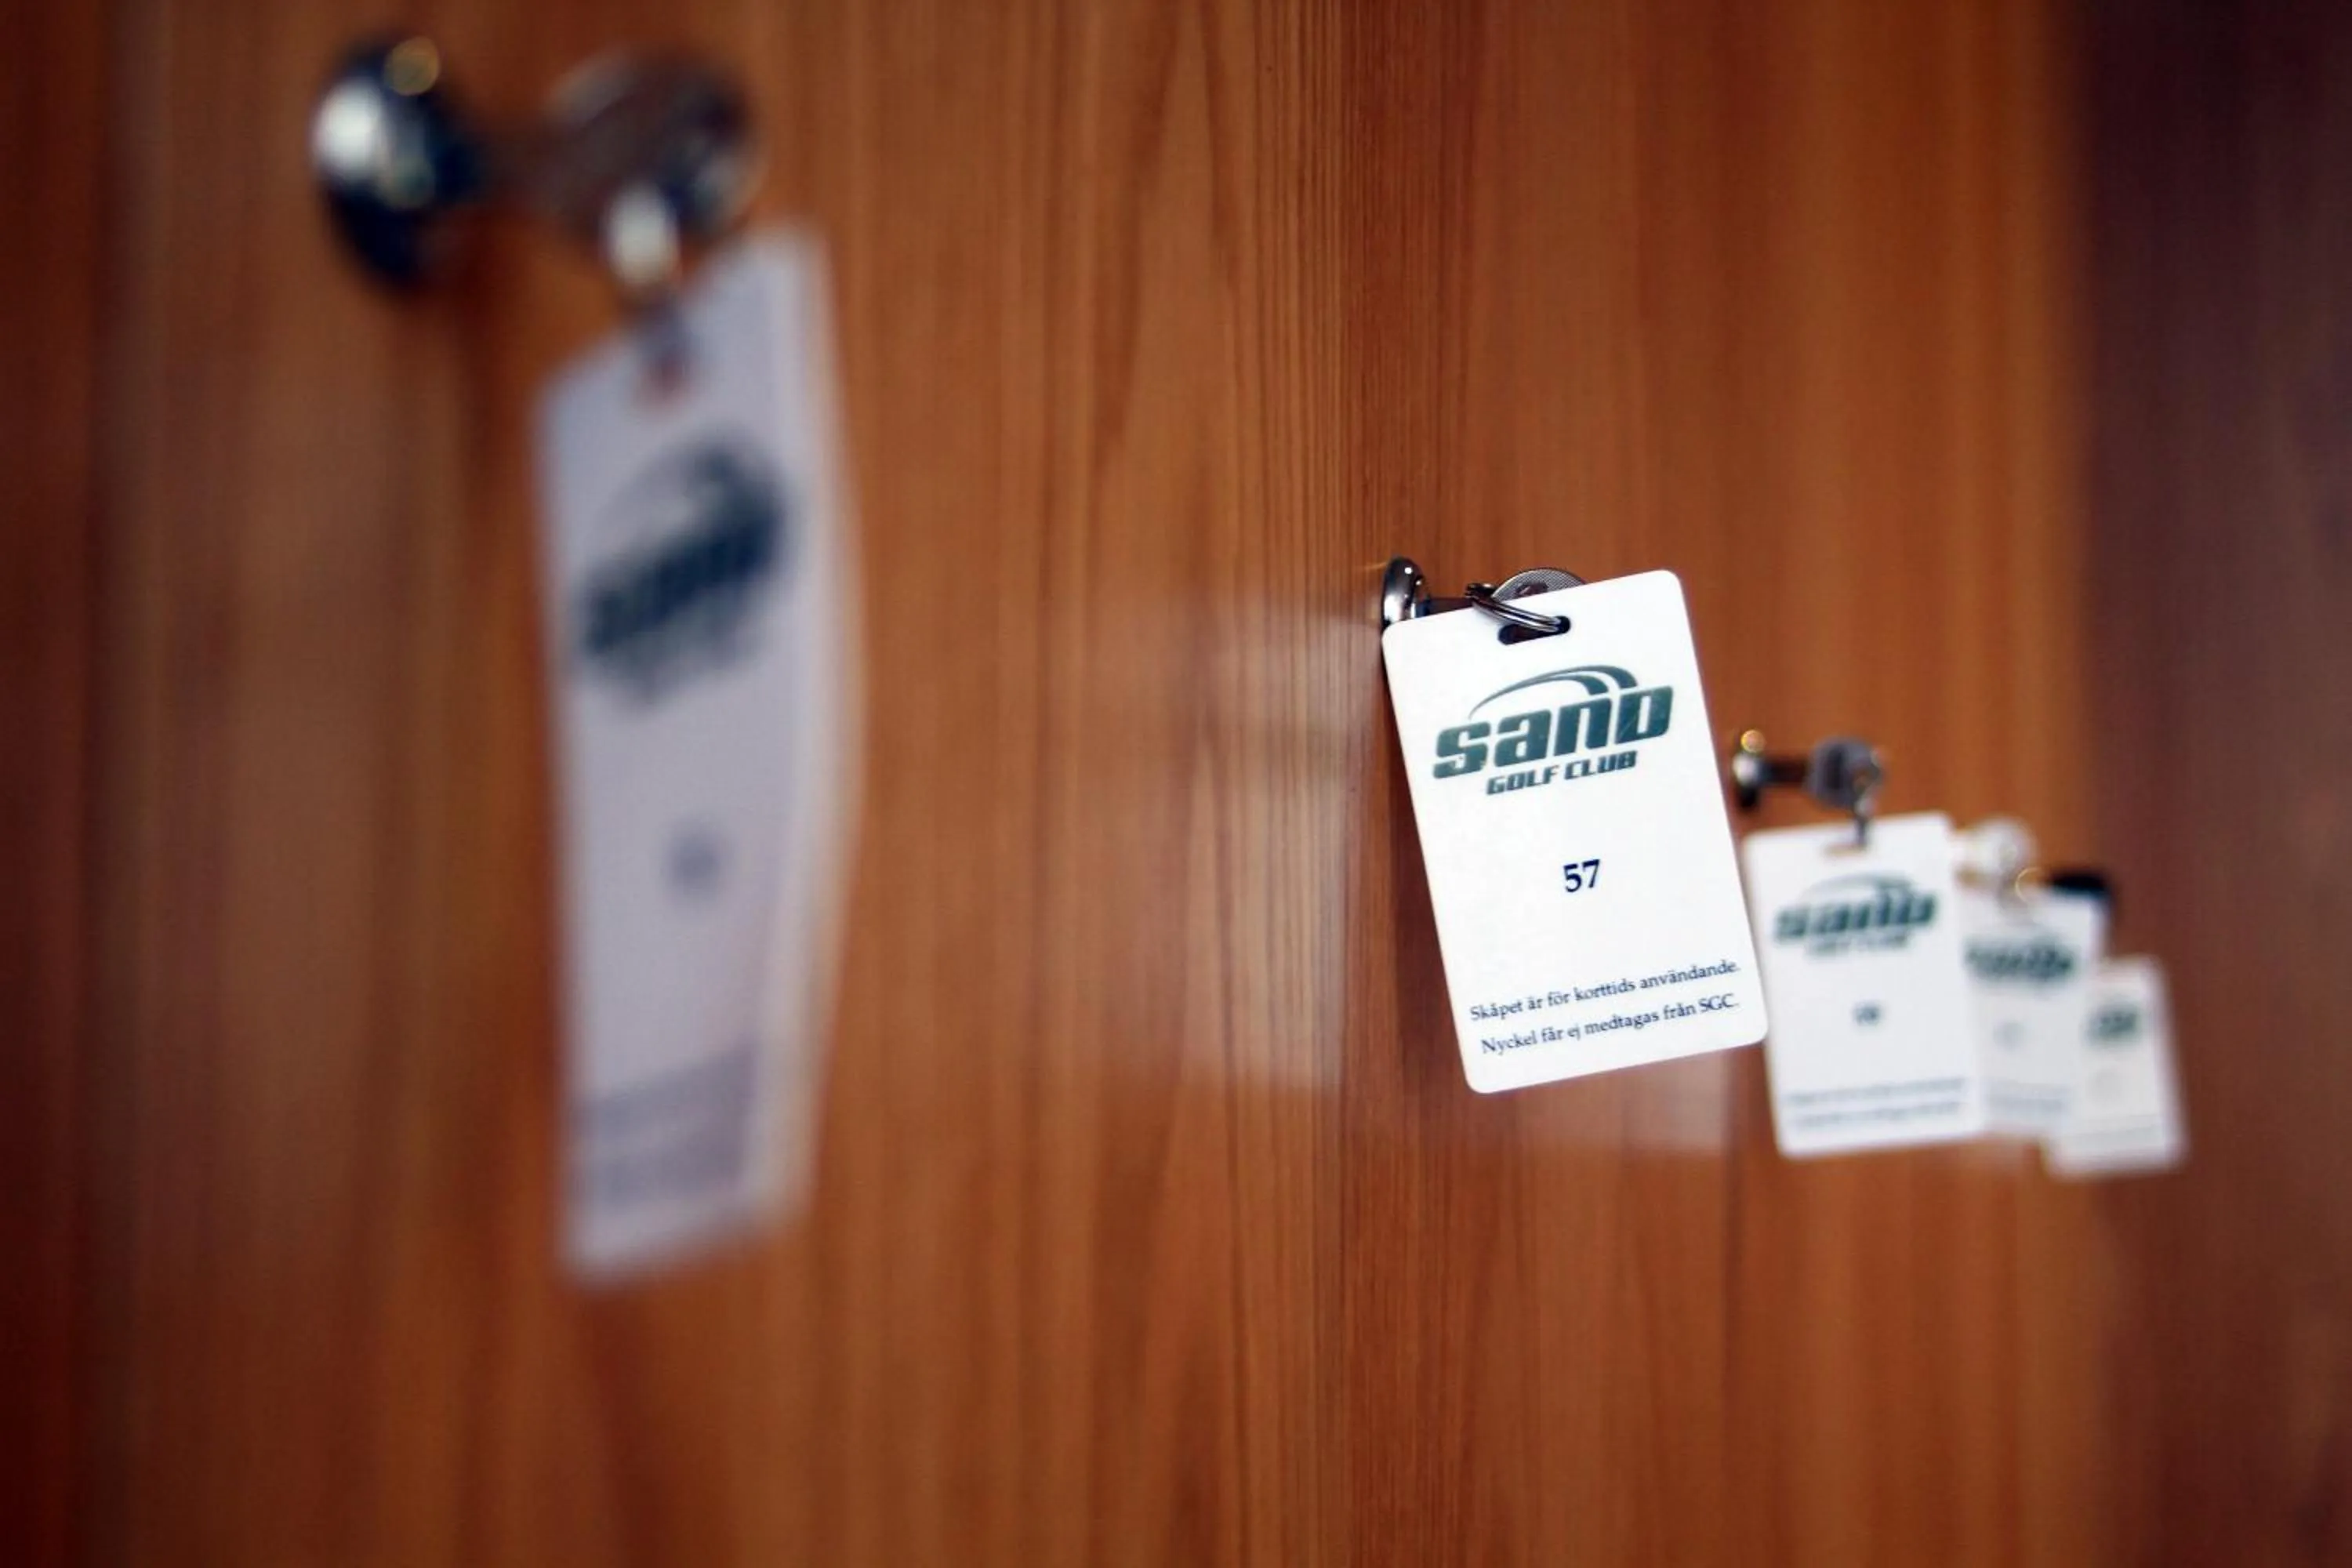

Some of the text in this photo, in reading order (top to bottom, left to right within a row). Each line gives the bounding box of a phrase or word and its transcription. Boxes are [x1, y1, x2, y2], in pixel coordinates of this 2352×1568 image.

[1486, 750, 1638, 796] GOLF CLUB
[1563, 858, 1601, 893] 57
[1469, 1000, 1523, 1021] Skåpet
[1528, 996, 1544, 1011] är
[1548, 991, 1570, 1007] för
[1573, 978, 1636, 1001] korttids
[1481, 1029, 1538, 1056] Nyckel
[1541, 1025, 1564, 1043] får
[1567, 1023, 1581, 1041] ej
[1584, 1013, 1660, 1036] medtagas
[1663, 1002, 1697, 1020] från
